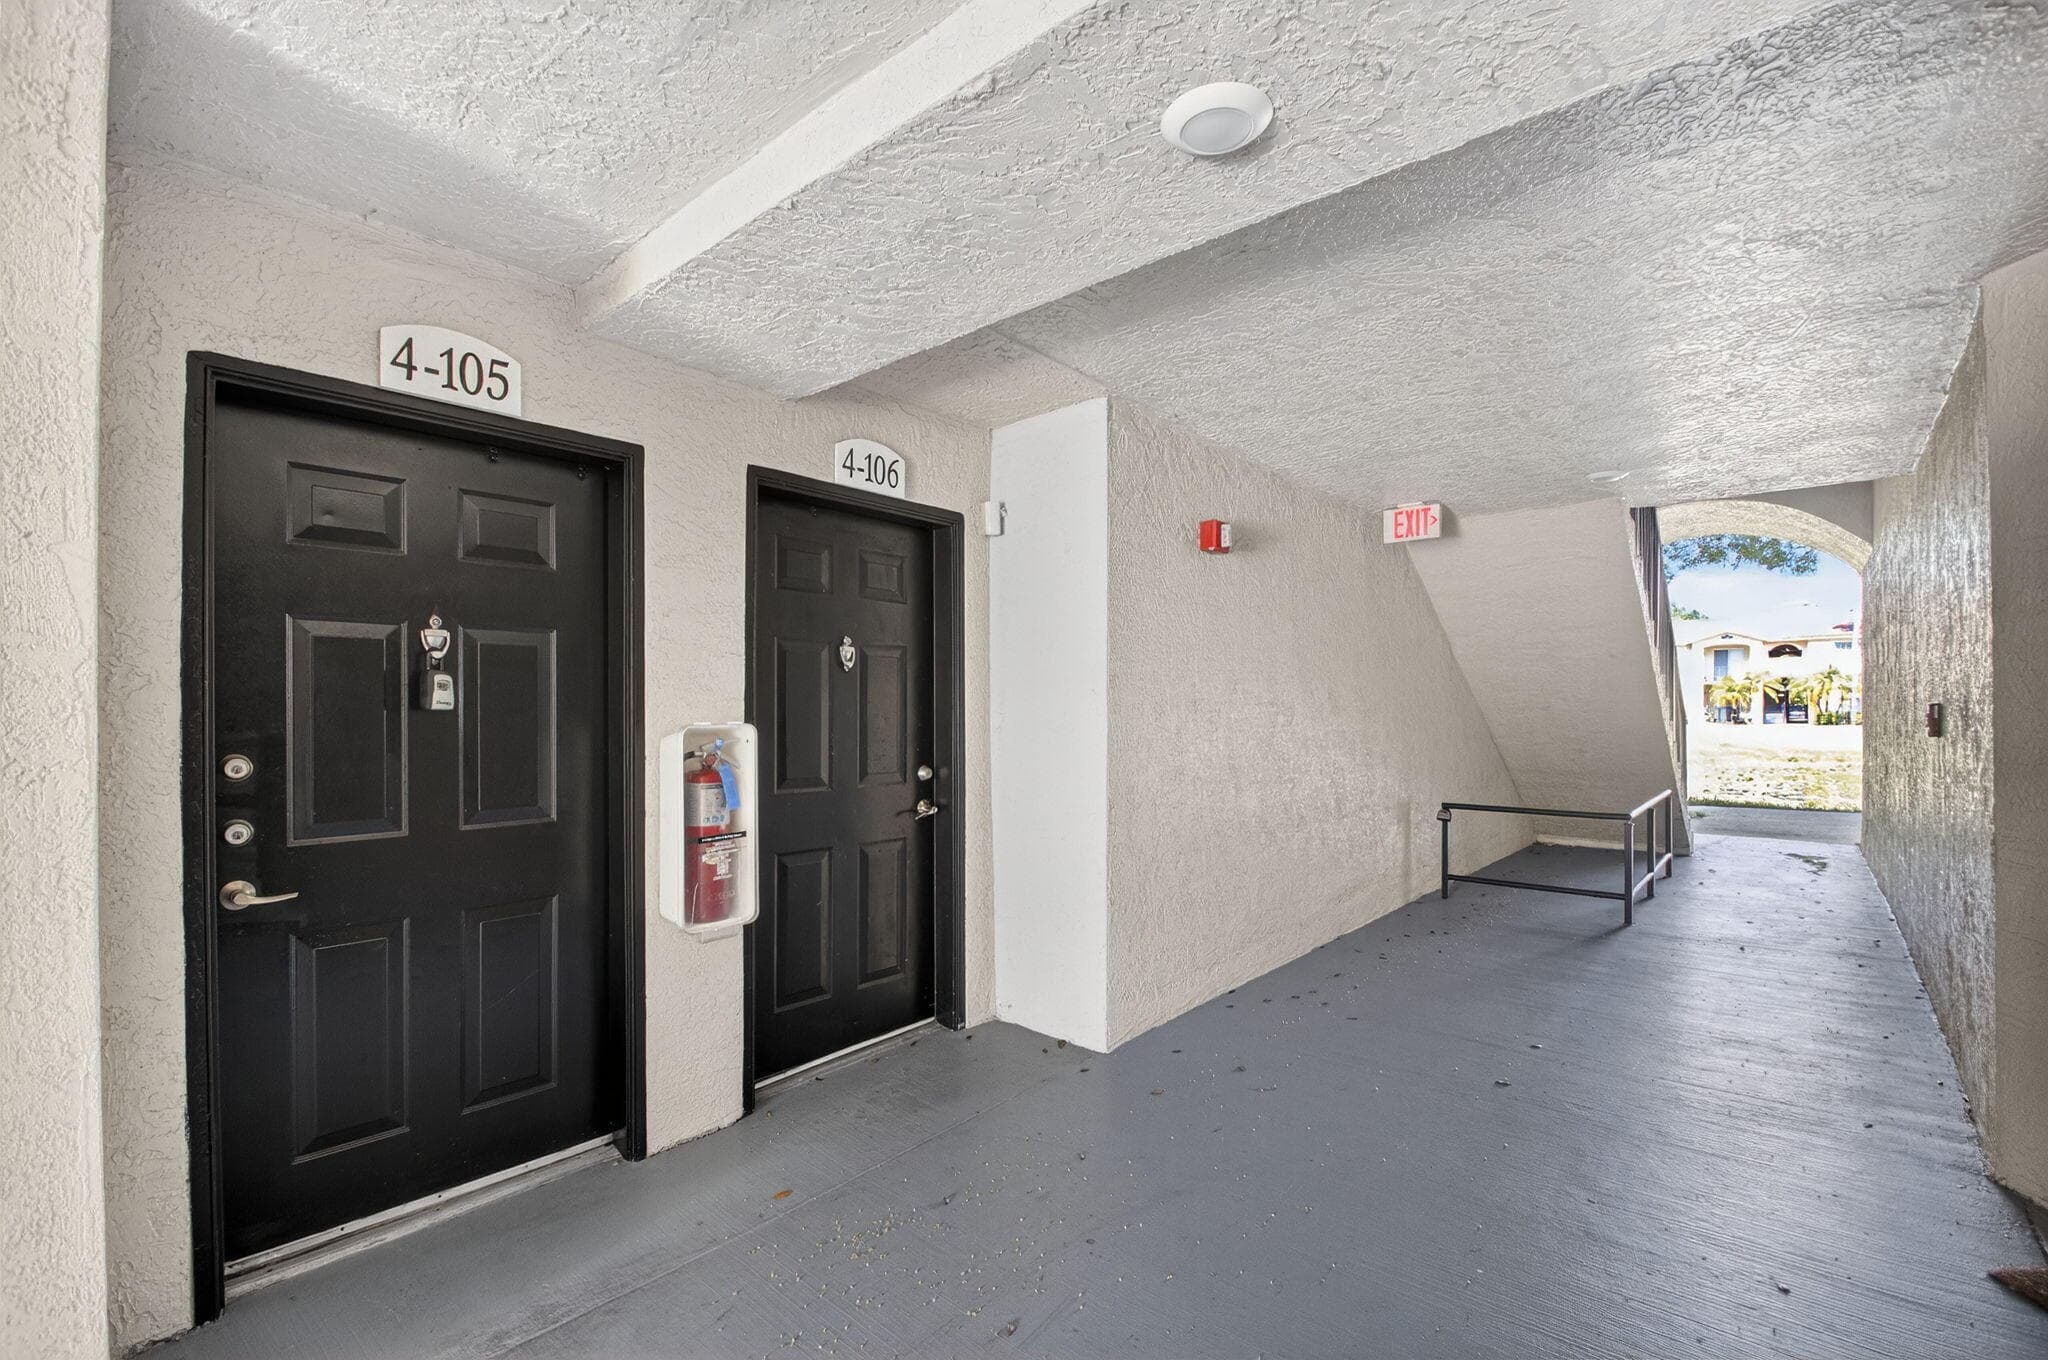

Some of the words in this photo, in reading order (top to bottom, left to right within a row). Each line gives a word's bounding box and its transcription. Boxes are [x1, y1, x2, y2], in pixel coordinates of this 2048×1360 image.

[390, 337, 509, 400] 4-105
[842, 448, 899, 488] 4-106
[1394, 508, 1431, 538] EXIT
